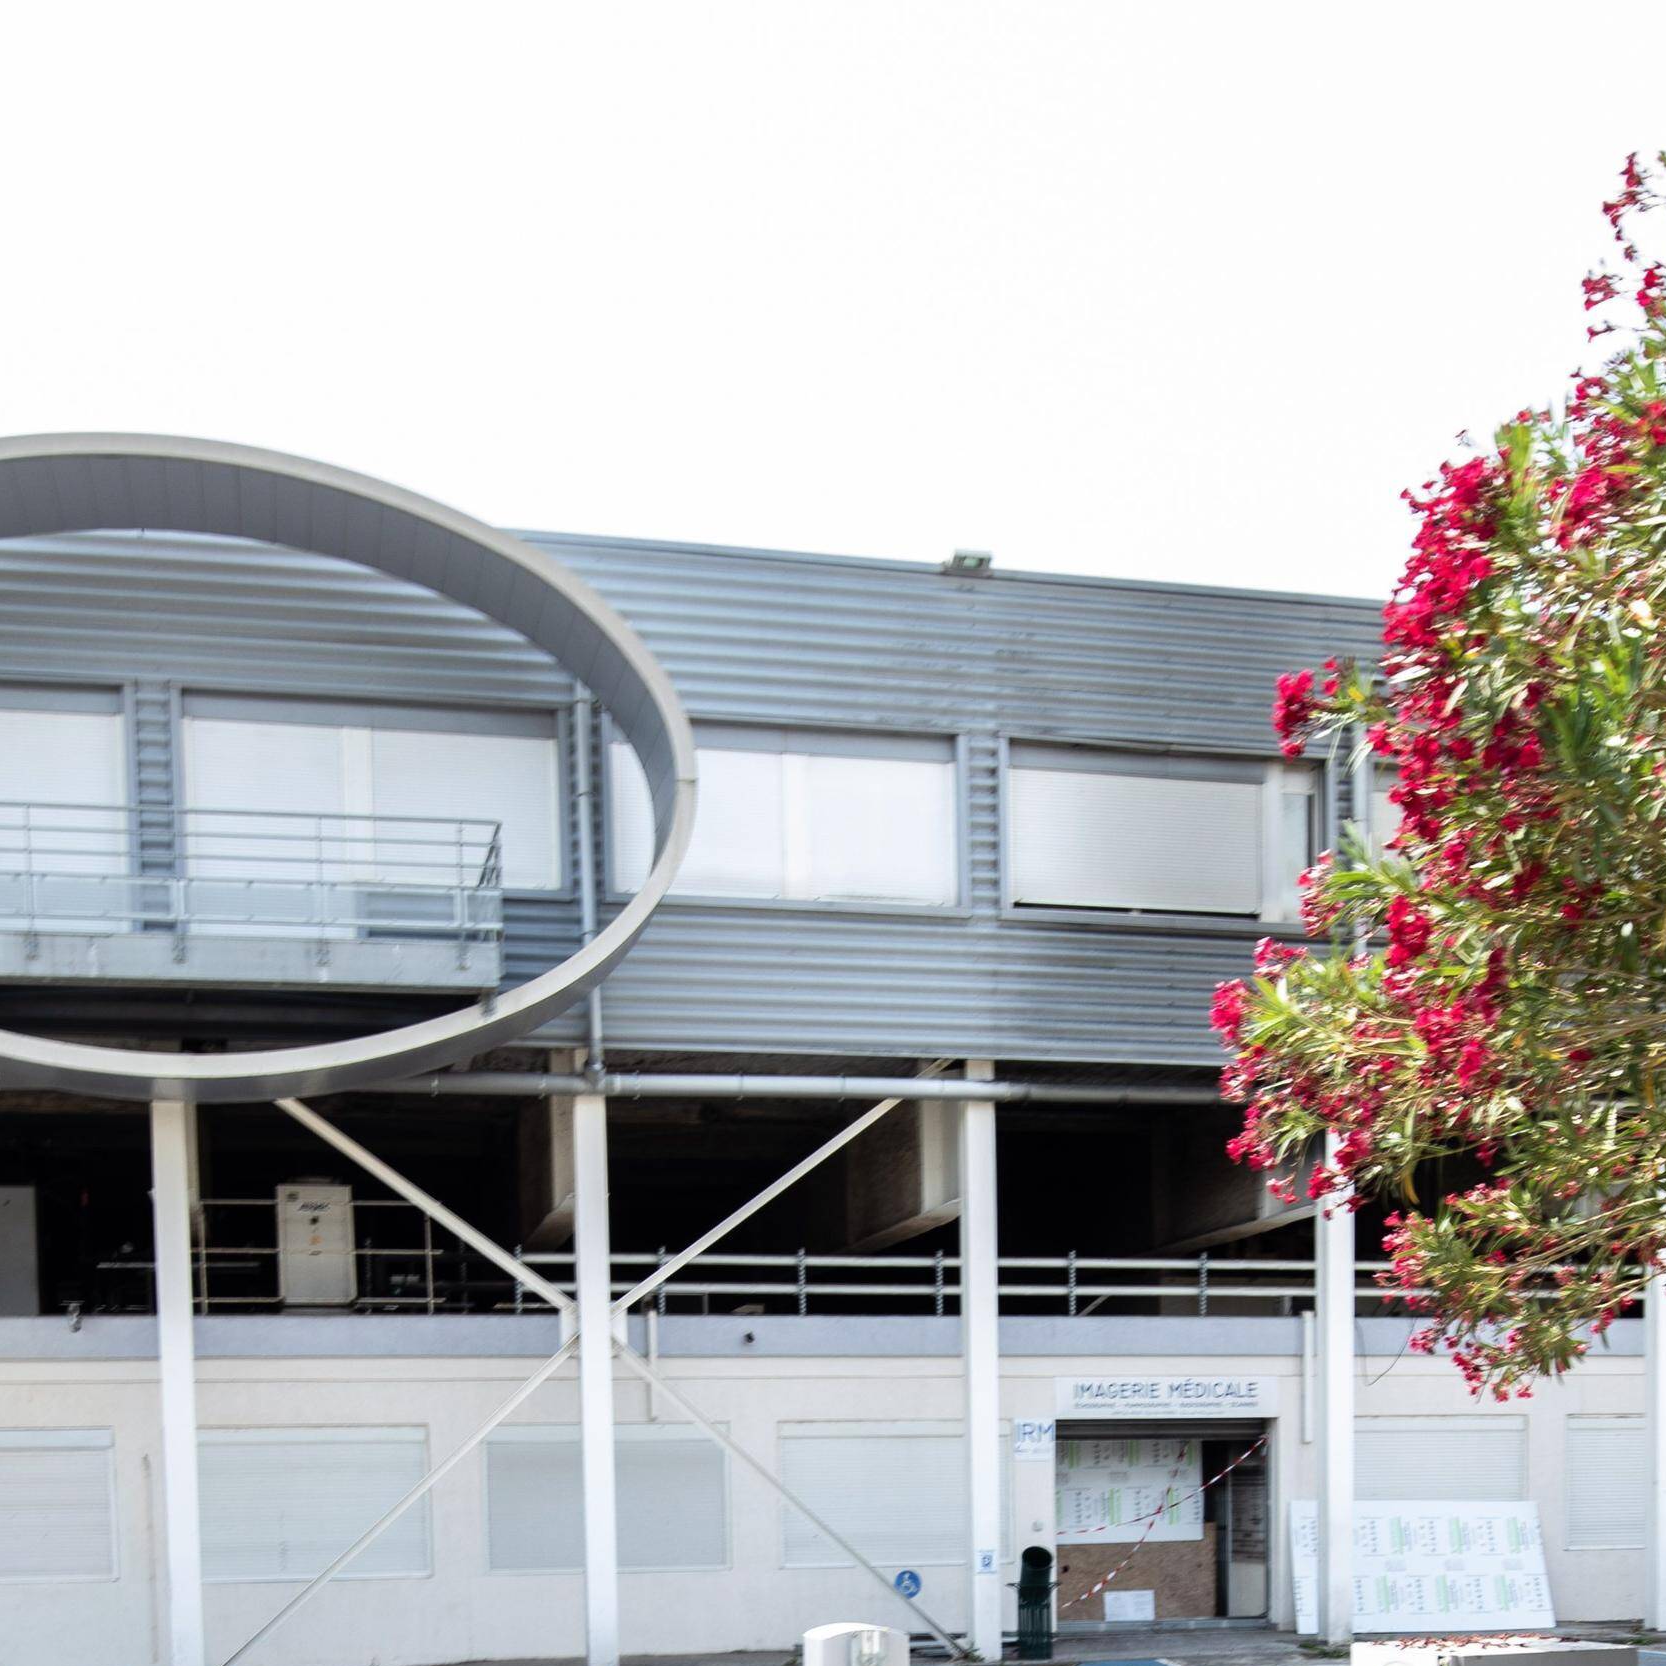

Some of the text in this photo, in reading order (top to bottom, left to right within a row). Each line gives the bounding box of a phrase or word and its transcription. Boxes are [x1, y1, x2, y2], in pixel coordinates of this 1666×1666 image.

[1072, 1378, 1259, 1399] IMAGERIE MÉDICALE
[1016, 1422, 1055, 1442] IRM
